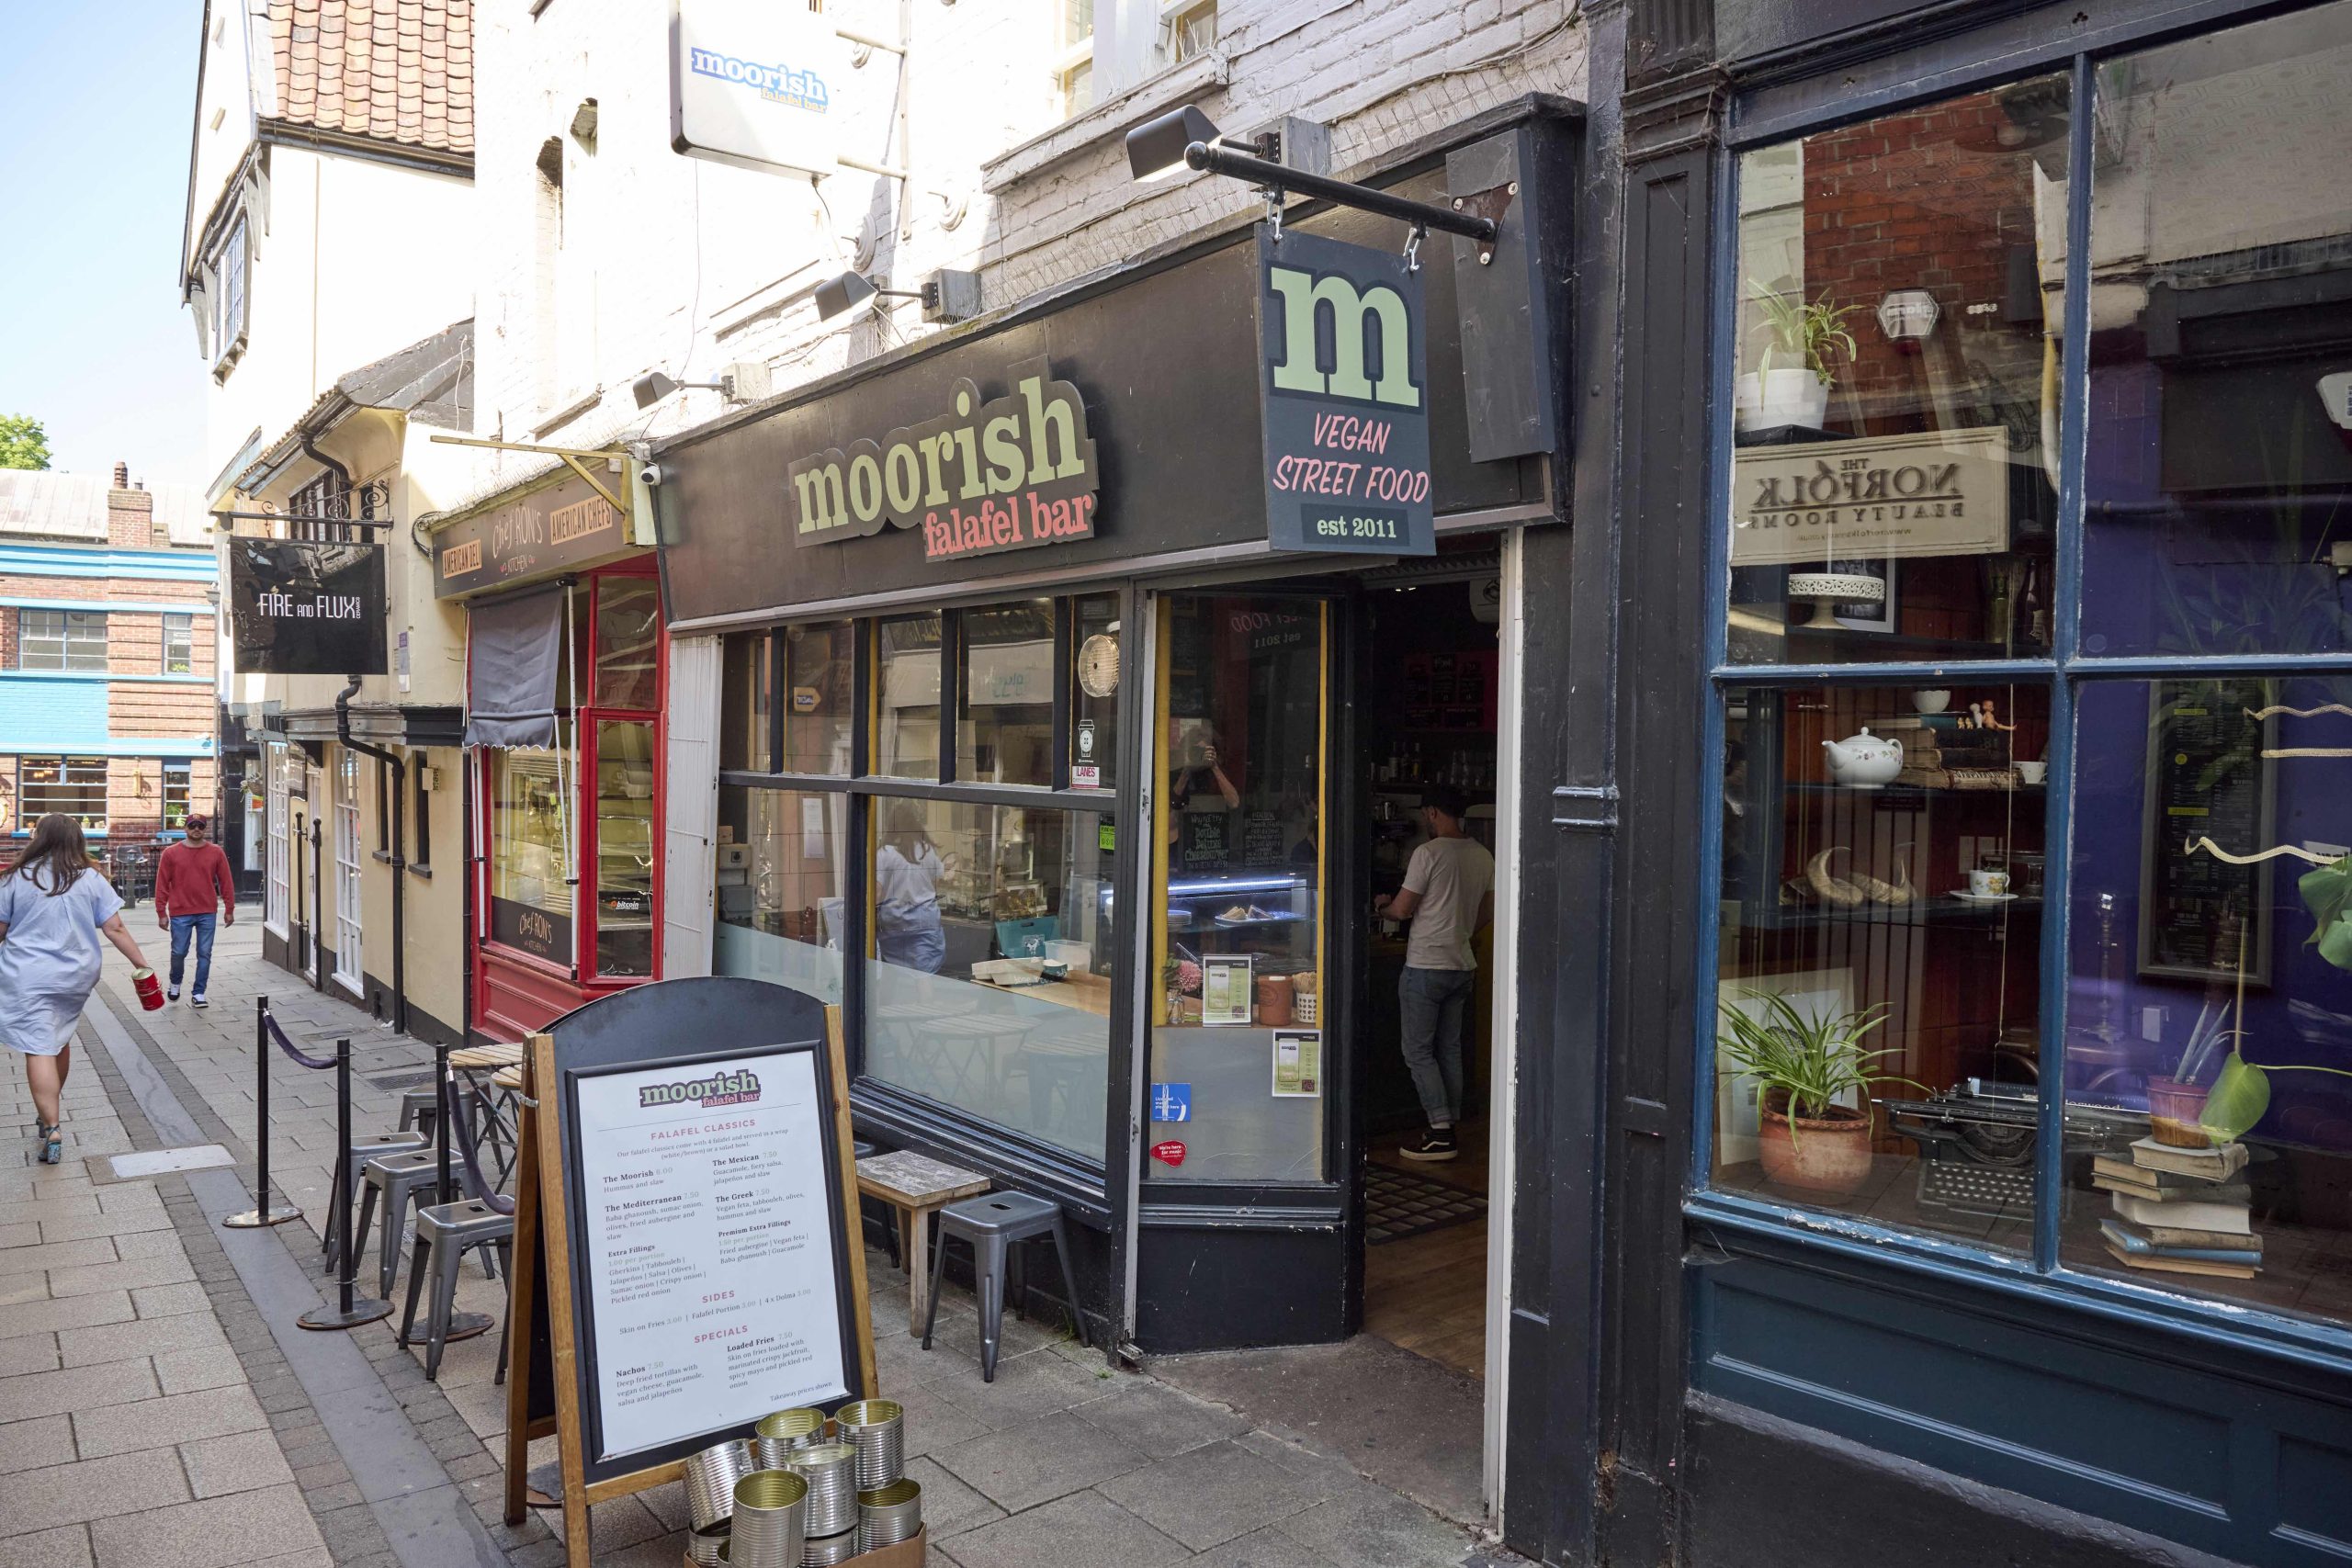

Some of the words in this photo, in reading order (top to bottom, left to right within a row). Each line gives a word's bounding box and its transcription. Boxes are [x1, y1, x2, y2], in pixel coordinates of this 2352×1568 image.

[693, 50, 826, 102] moorish
[762, 87, 801, 108] falafel
[804, 96, 826, 113] bar
[1271, 266, 1419, 408] m
[1314, 412, 1391, 455] VEGAN
[795, 376, 1085, 535] moorish
[1272, 455, 1361, 496] STREET
[1365, 467, 1429, 503] FOOD
[552, 508, 586, 541] AMERICAN
[588, 498, 611, 530] CHEFS
[926, 496, 1023, 557] falafel
[1026, 491, 1091, 540] bar
[1317, 515, 1348, 536] est
[1352, 517, 1397, 538] 2011
[492, 517, 513, 558] Chef
[514, 507, 543, 545] RON'S
[444, 548, 469, 574] AMERICAN
[469, 542, 481, 568] DELI
[508, 556, 527, 573] KITCHEN
[259, 593, 293, 616] FIRE
[297, 604, 314, 617] AND
[316, 596, 356, 619] FLUX
[1076, 766, 1095, 777] LANES
[519, 911, 534, 935] Chef
[535, 913, 552, 943] RON'S
[641, 1071, 759, 1105] moorish
[650, 1128, 700, 1140] FALAFEL
[704, 1120, 755, 1133] CLASSICS
[729, 1156, 760, 1164] Mexican
[620, 1170, 654, 1181] Moorish
[605, 1204, 620, 1213] The
[623, 1196, 682, 1210] Mediterranean
[715, 1195, 729, 1203] The
[731, 1191, 753, 1201] Greek
[718, 1229, 748, 1237] Premium
[768, 1220, 791, 1228] Fillings
[629, 1246, 655, 1254] Fillings
[702, 1291, 735, 1303] SIDES
[695, 1325, 748, 1344] SPECIALS
[727, 1341, 754, 1352] Loaded
[616, 1367, 646, 1378] Nachos
